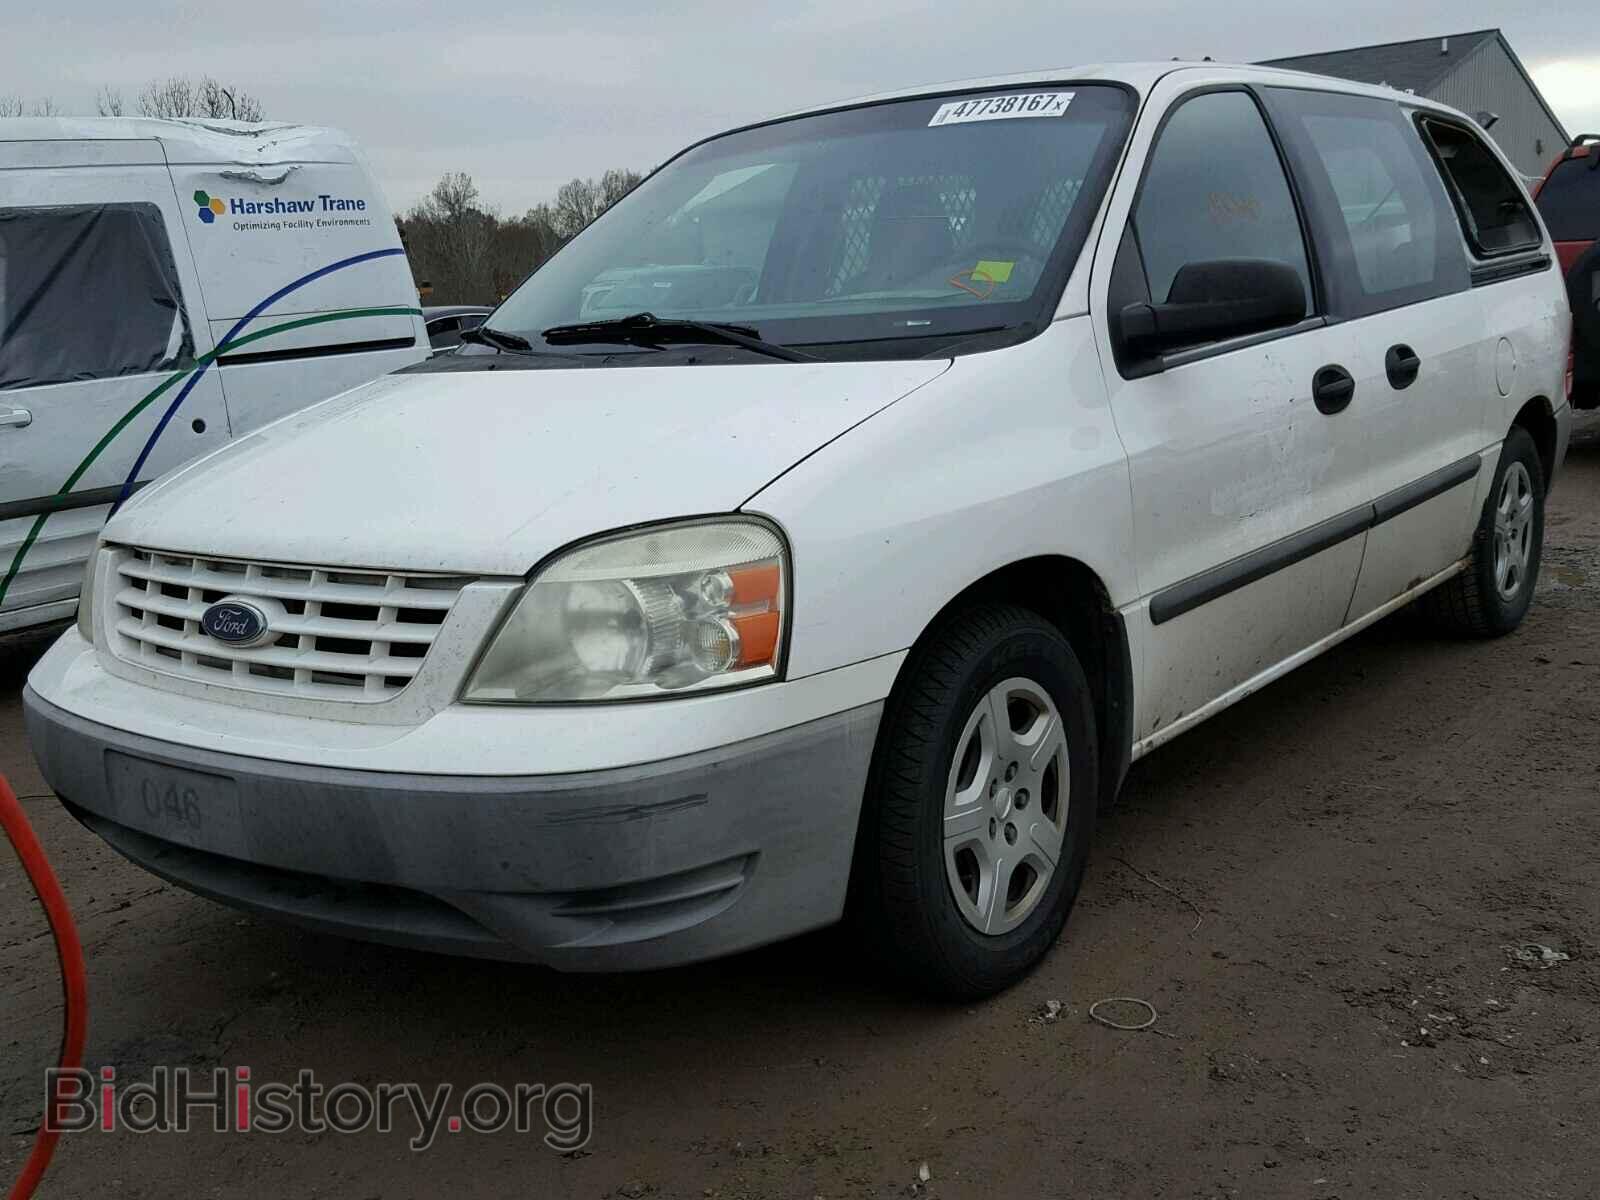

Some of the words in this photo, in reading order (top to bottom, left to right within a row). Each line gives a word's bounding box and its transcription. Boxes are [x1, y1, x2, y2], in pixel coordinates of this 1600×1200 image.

[230, 198, 315, 214] Harshaw
[318, 195, 366, 211] Trane
[233, 222, 281, 231] Optimizing
[283, 221, 314, 230] Facility
[316, 218, 370, 228] Environments
[214, 608, 249, 634] Ford
